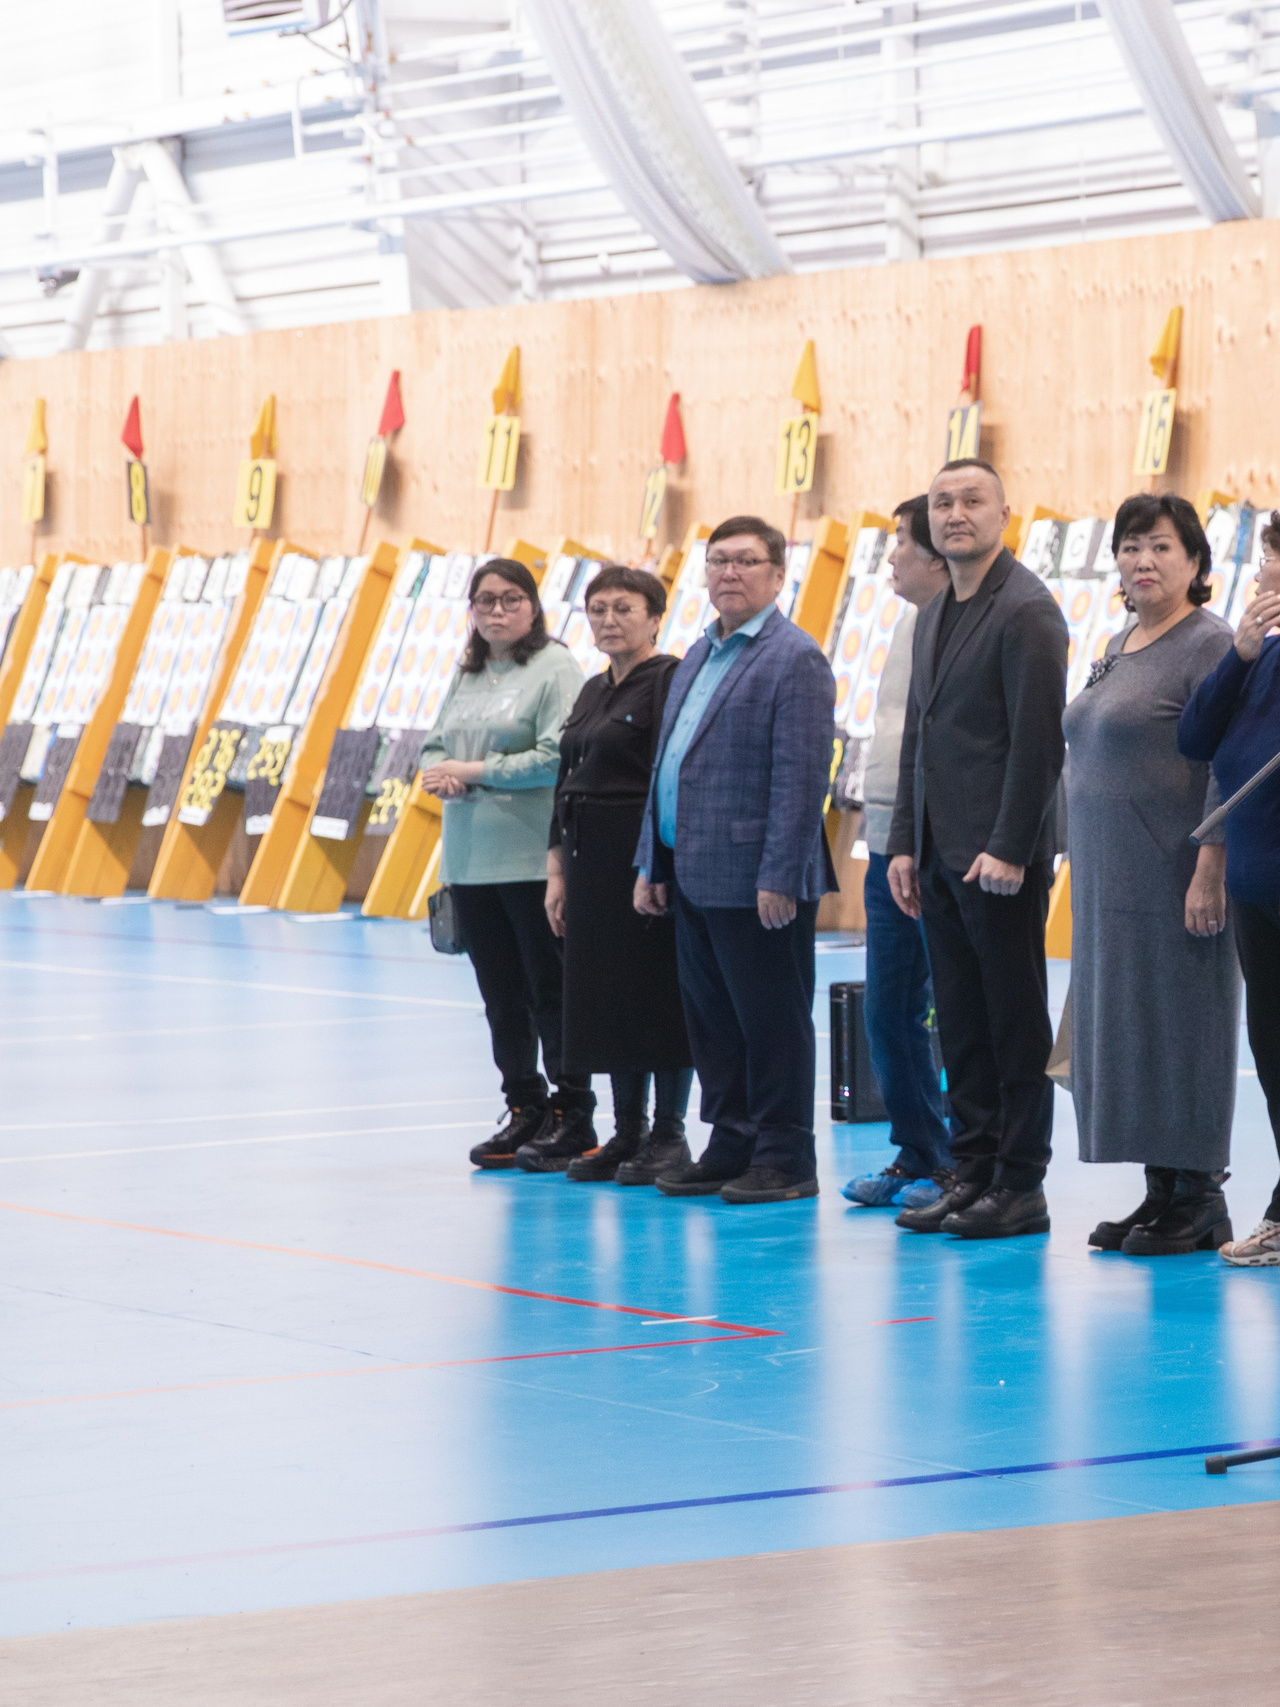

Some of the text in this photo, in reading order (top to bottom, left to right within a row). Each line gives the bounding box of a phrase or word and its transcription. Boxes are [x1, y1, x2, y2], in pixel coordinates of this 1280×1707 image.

[484, 421, 512, 484] 11
[783, 420, 810, 488] 13
[1142, 395, 1171, 468] 15
[130, 460, 147, 524] 8
[247, 465, 262, 522] 9
[1071, 534, 1085, 558] C
